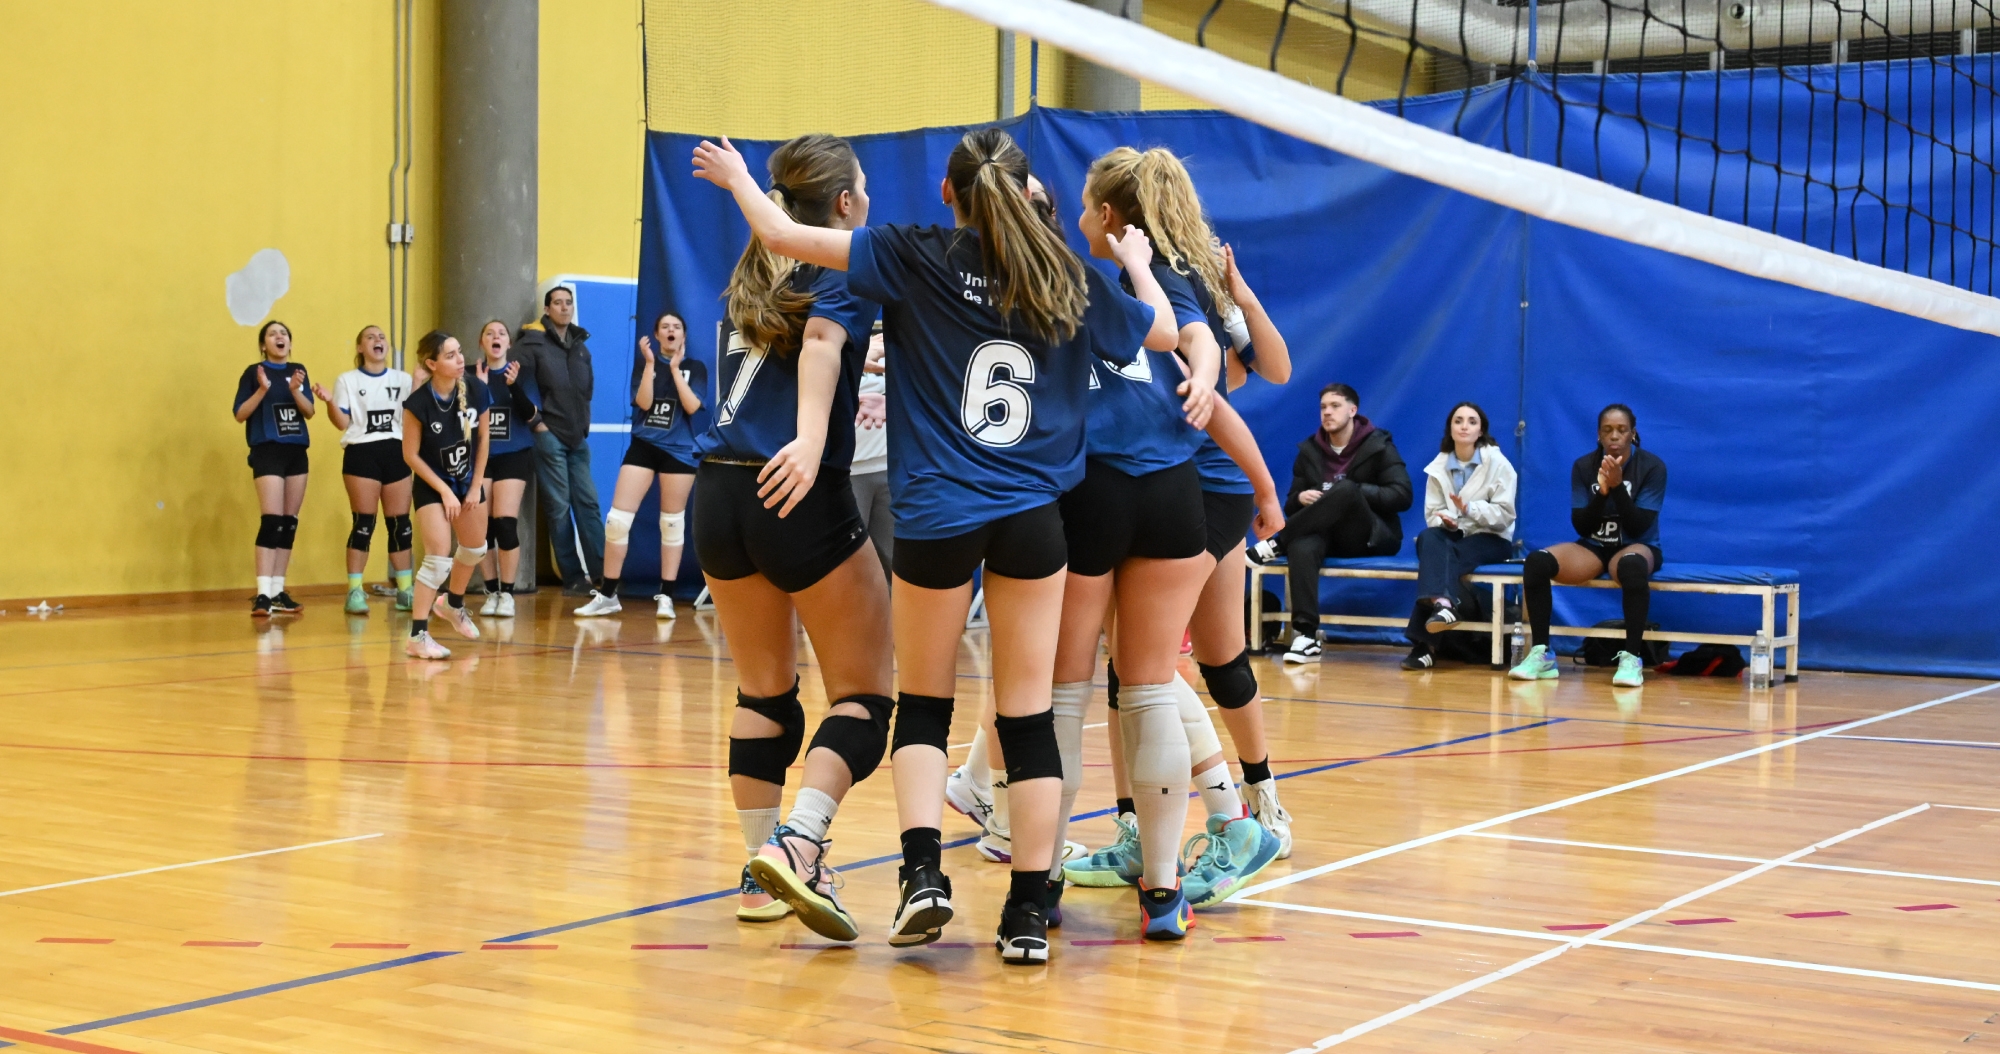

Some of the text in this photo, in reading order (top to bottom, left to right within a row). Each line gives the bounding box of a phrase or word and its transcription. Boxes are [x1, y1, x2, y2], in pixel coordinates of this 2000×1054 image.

[717, 330, 771, 427] 7
[385, 386, 401, 402] 17
[960, 339, 1036, 448] 6
[279, 408, 297, 421] UP
[371, 413, 392, 426] UP
[457, 407, 480, 431] 12
[448, 446, 467, 466] UP
